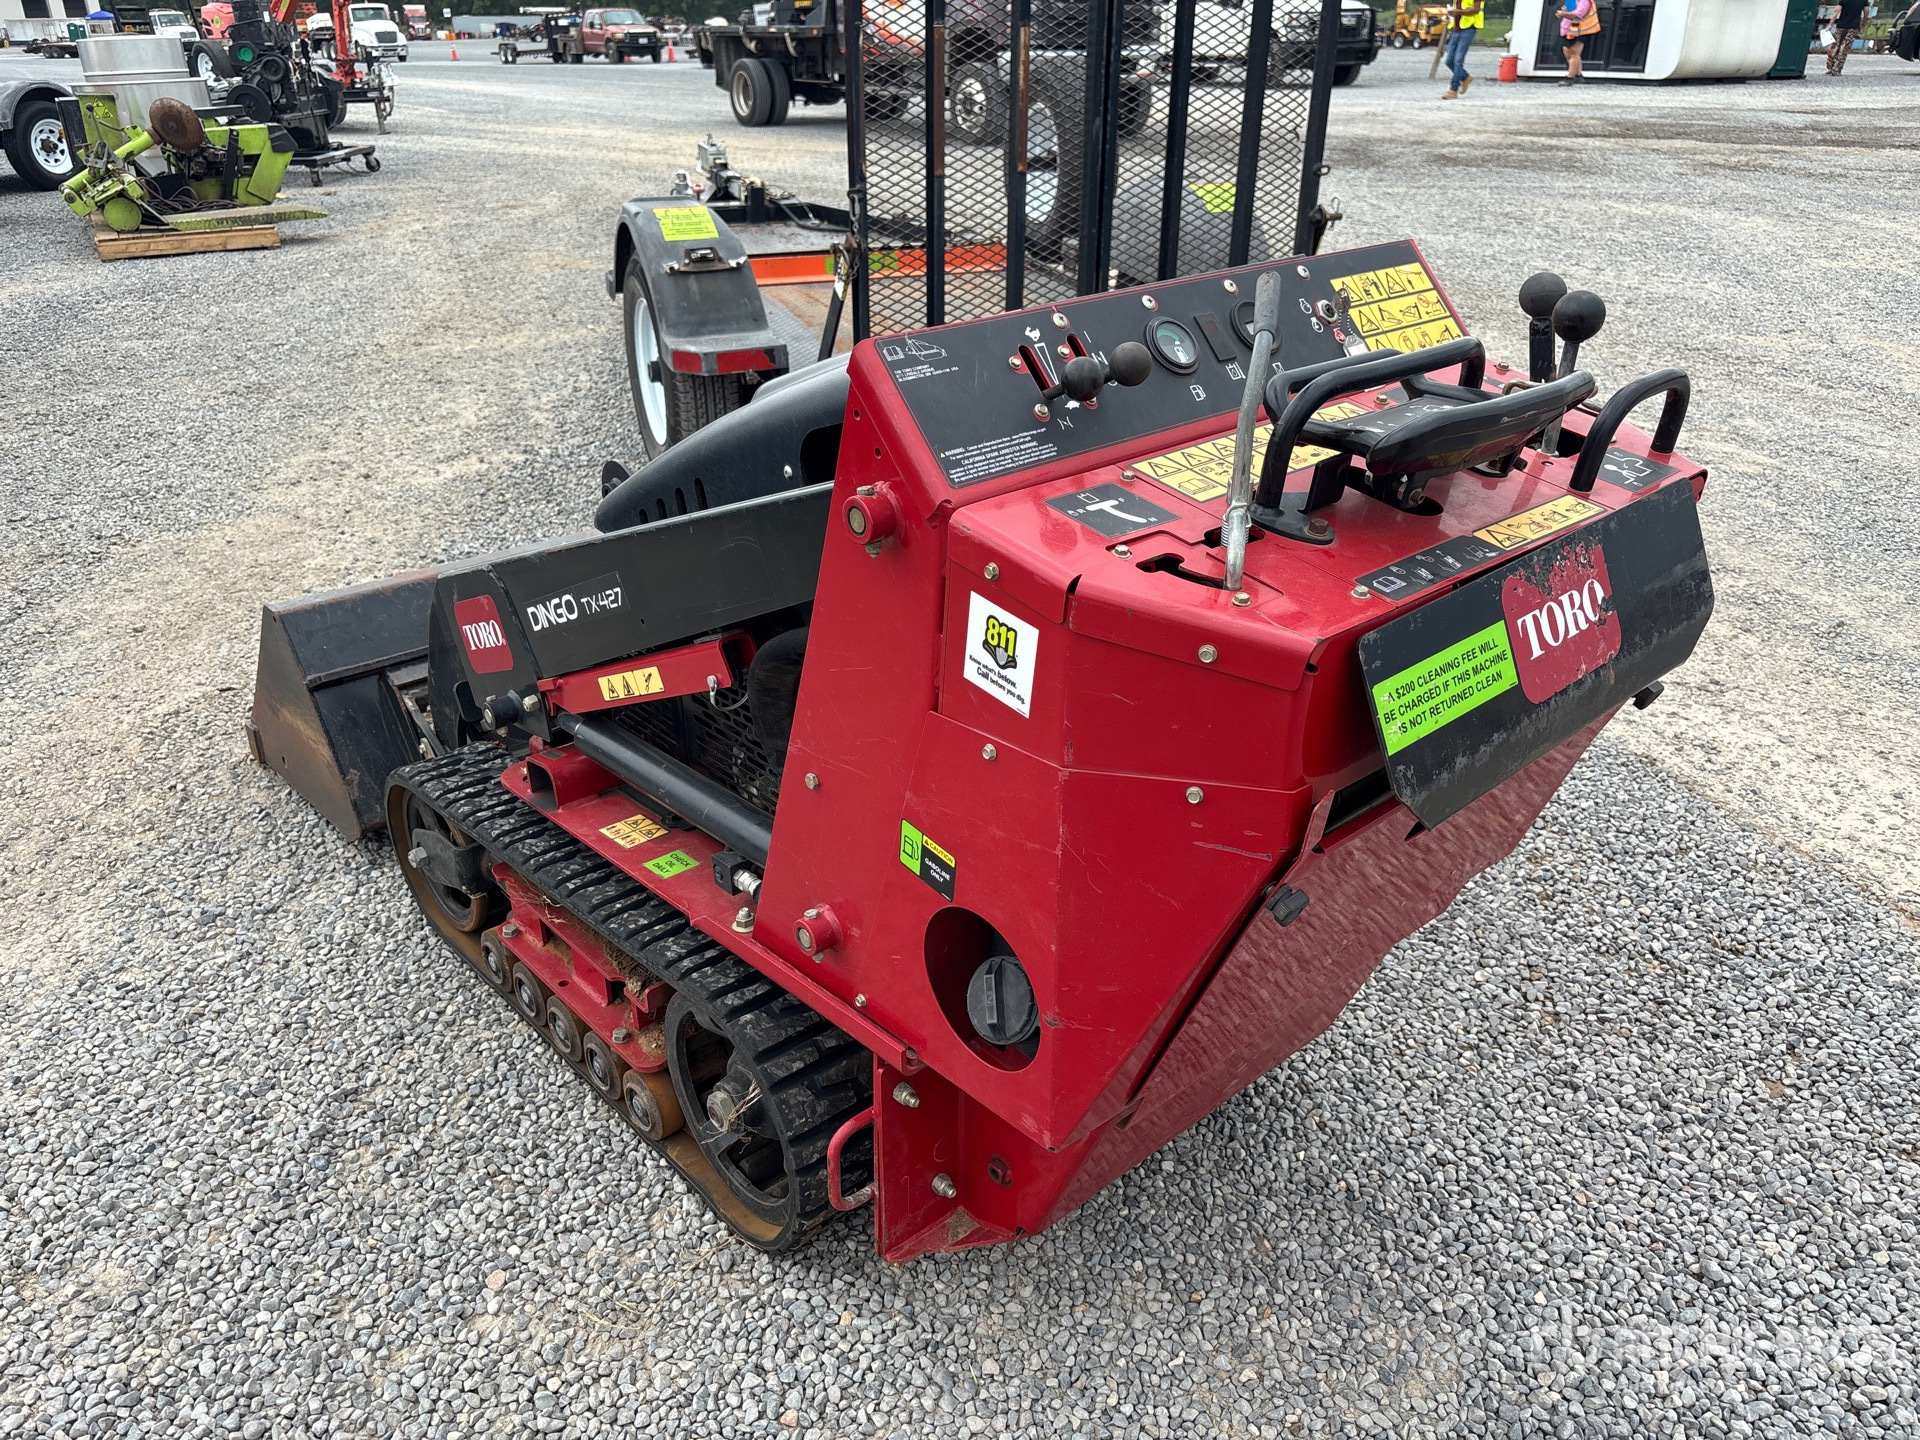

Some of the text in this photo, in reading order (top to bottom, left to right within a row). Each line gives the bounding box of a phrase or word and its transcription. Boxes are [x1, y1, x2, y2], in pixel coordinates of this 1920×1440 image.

[961, 455, 985, 464] CALIFORNIA
[999, 446, 1020, 454] ARRESTER
[1020, 441, 1038, 449] WARNING
[526, 593, 579, 633] DINGO
[1516, 578, 1605, 661] TORO
[462, 619, 503, 651] TORO
[986, 617, 1016, 656] 811
[969, 654, 1018, 689] Know what's below.
[976, 666, 1026, 704] Call before you dig.
[1395, 680, 1415, 699] $200
[1417, 657, 1460, 687] CLEANING
[1461, 648, 1478, 664] FEE
[1478, 638, 1498, 655] WILL
[1383, 649, 1508, 724] BE CHARGED IF THIS MACHINE
[1398, 670, 1502, 735] IS NOT RETURNED CLEAN
[652, 862, 671, 874] DAILY
[665, 860, 676, 869] OIL
[670, 853, 693, 868] CHECK
[924, 857, 951, 881] GASOLINE
[929, 841, 953, 864] CAUTION
[930, 869, 944, 883] ONLY
